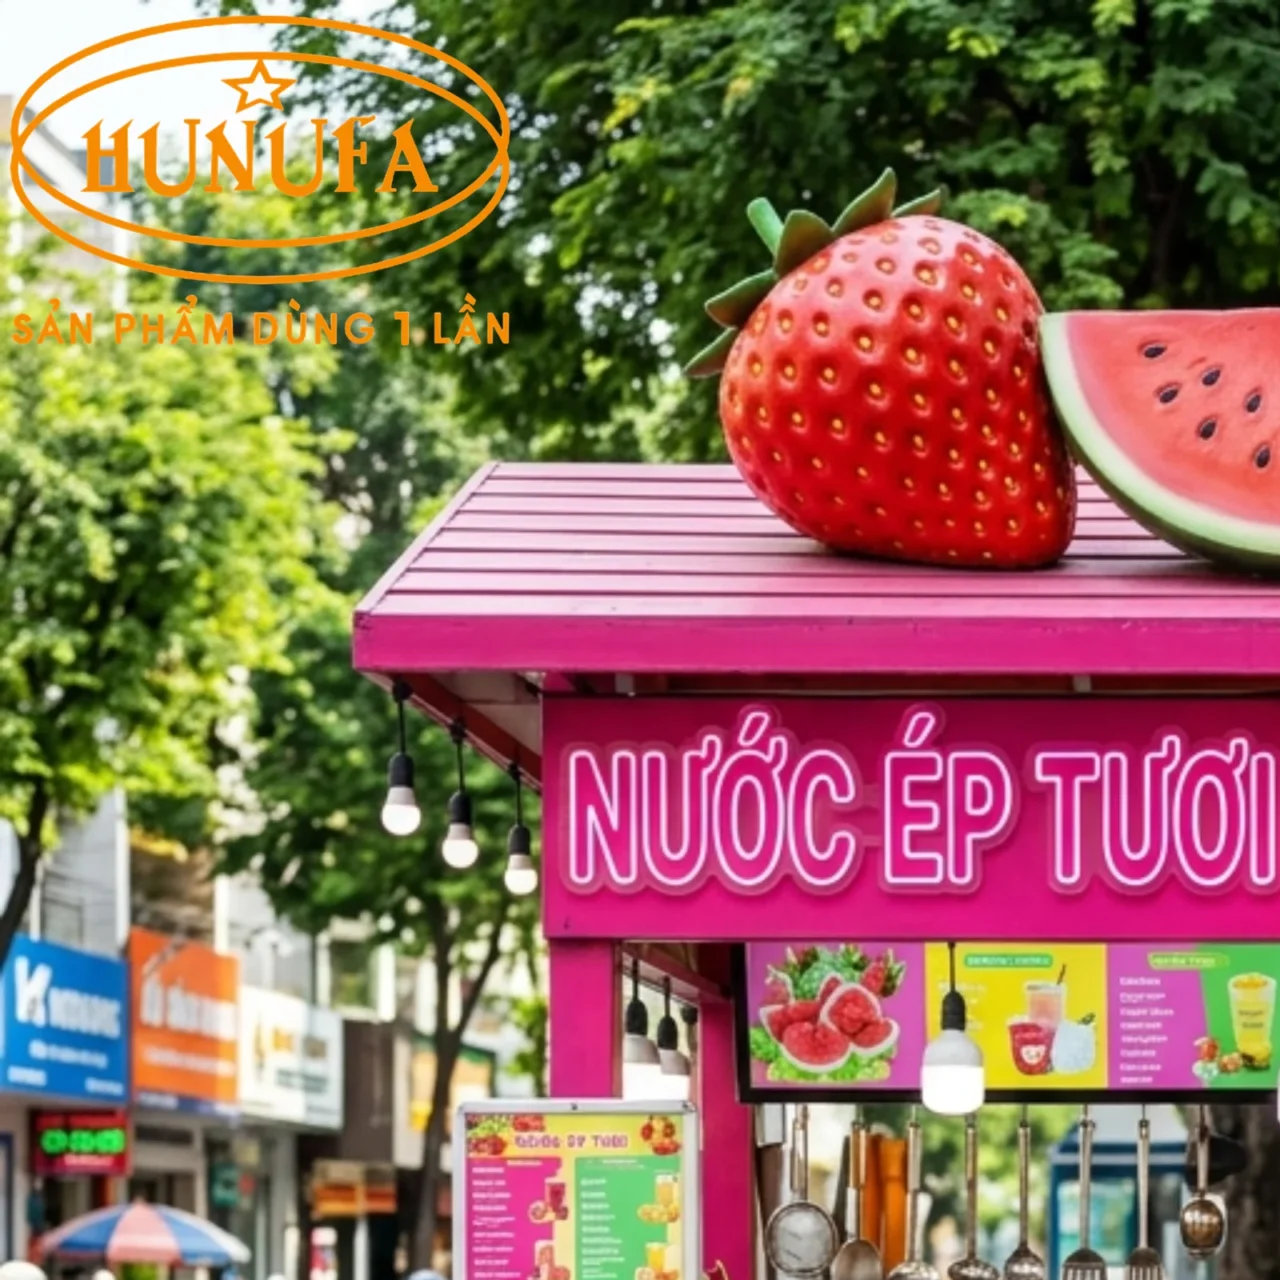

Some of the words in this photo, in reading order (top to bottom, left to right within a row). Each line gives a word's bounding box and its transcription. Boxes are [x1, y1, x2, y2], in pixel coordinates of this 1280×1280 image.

[567, 710, 857, 887] NƯỚC
[883, 710, 1013, 887] ÉP
[1034, 734, 1277, 887] TƯƠI
